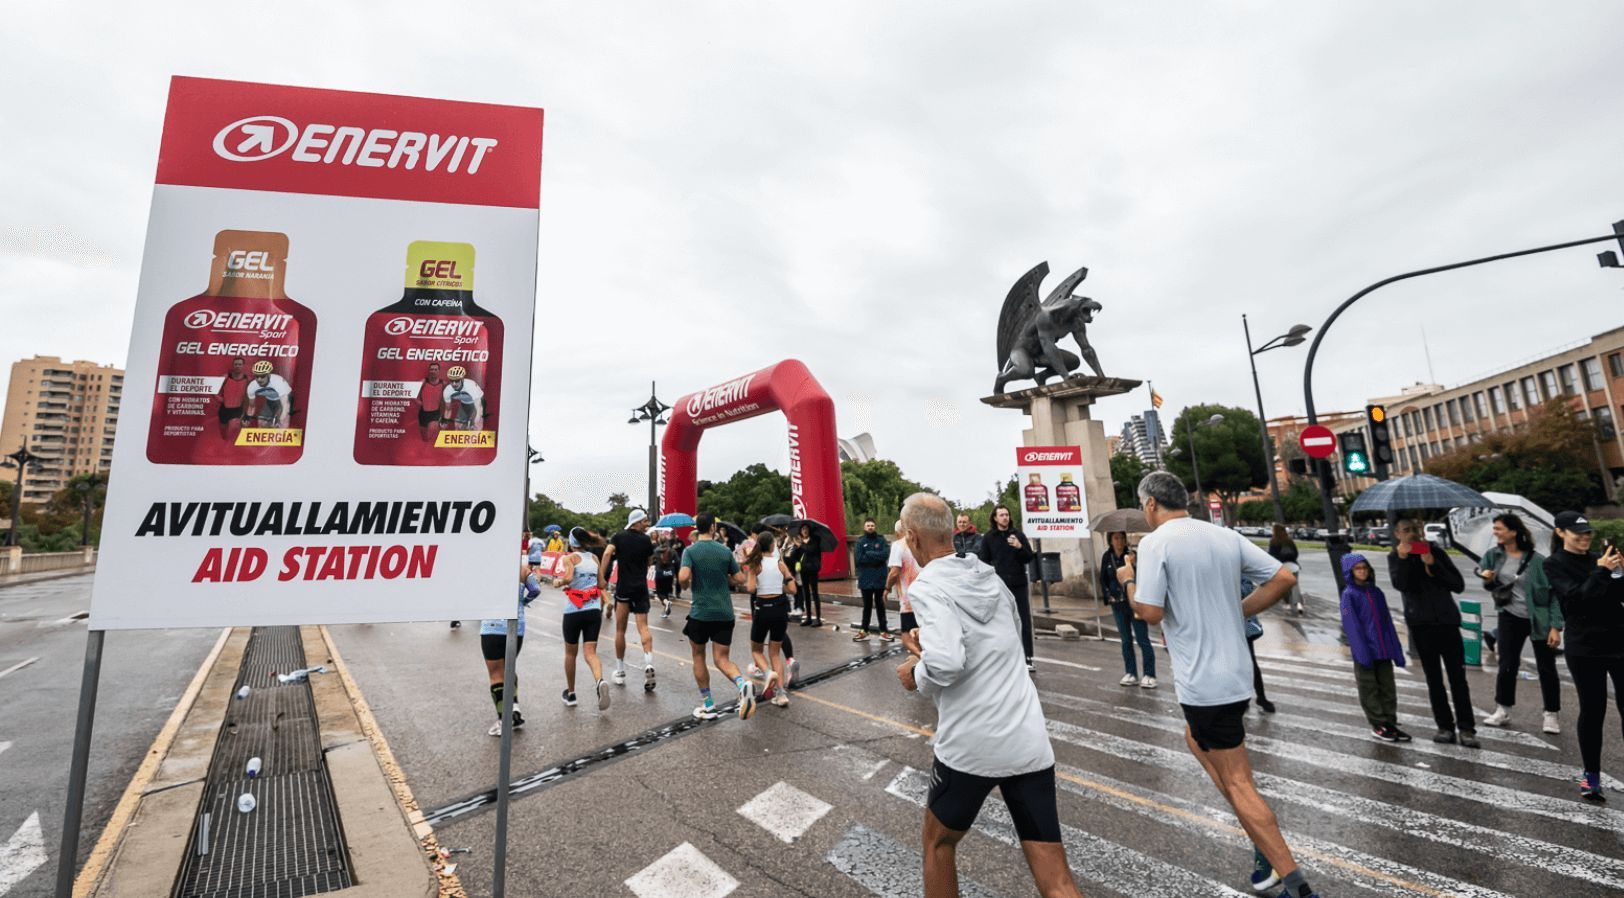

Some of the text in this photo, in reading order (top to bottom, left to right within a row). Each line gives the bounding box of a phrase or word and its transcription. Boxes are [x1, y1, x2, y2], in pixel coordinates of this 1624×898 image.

[291, 123, 498, 175] ENERVIT
[228, 250, 274, 271] GEL
[420, 259, 462, 279] GEL
[414, 298, 463, 307] CON CAFEÍNA
[213, 312, 293, 331] ENERVIT
[412, 319, 484, 336] ENERVIT
[258, 329, 288, 340] Sport
[453, 335, 479, 344] Sport
[176, 341, 299, 357] GEL ENERGÉTICO
[377, 347, 490, 362] GEL ENERGÉTICO
[171, 377, 205, 386] DURANTE
[180, 385, 213, 393] DEPORTE
[373, 382, 404, 390] DURANTE
[382, 389, 412, 397] DEPORTE
[704, 373, 757, 411] ENERVIT
[716, 411, 725, 420] in
[724, 402, 760, 417] Nutrition
[788, 422, 803, 497] ENERVIT
[1037, 452, 1073, 461] ENERVIT
[134, 500, 497, 537] AVITUALLAMIENTO
[191, 545, 438, 583] AID STATION
